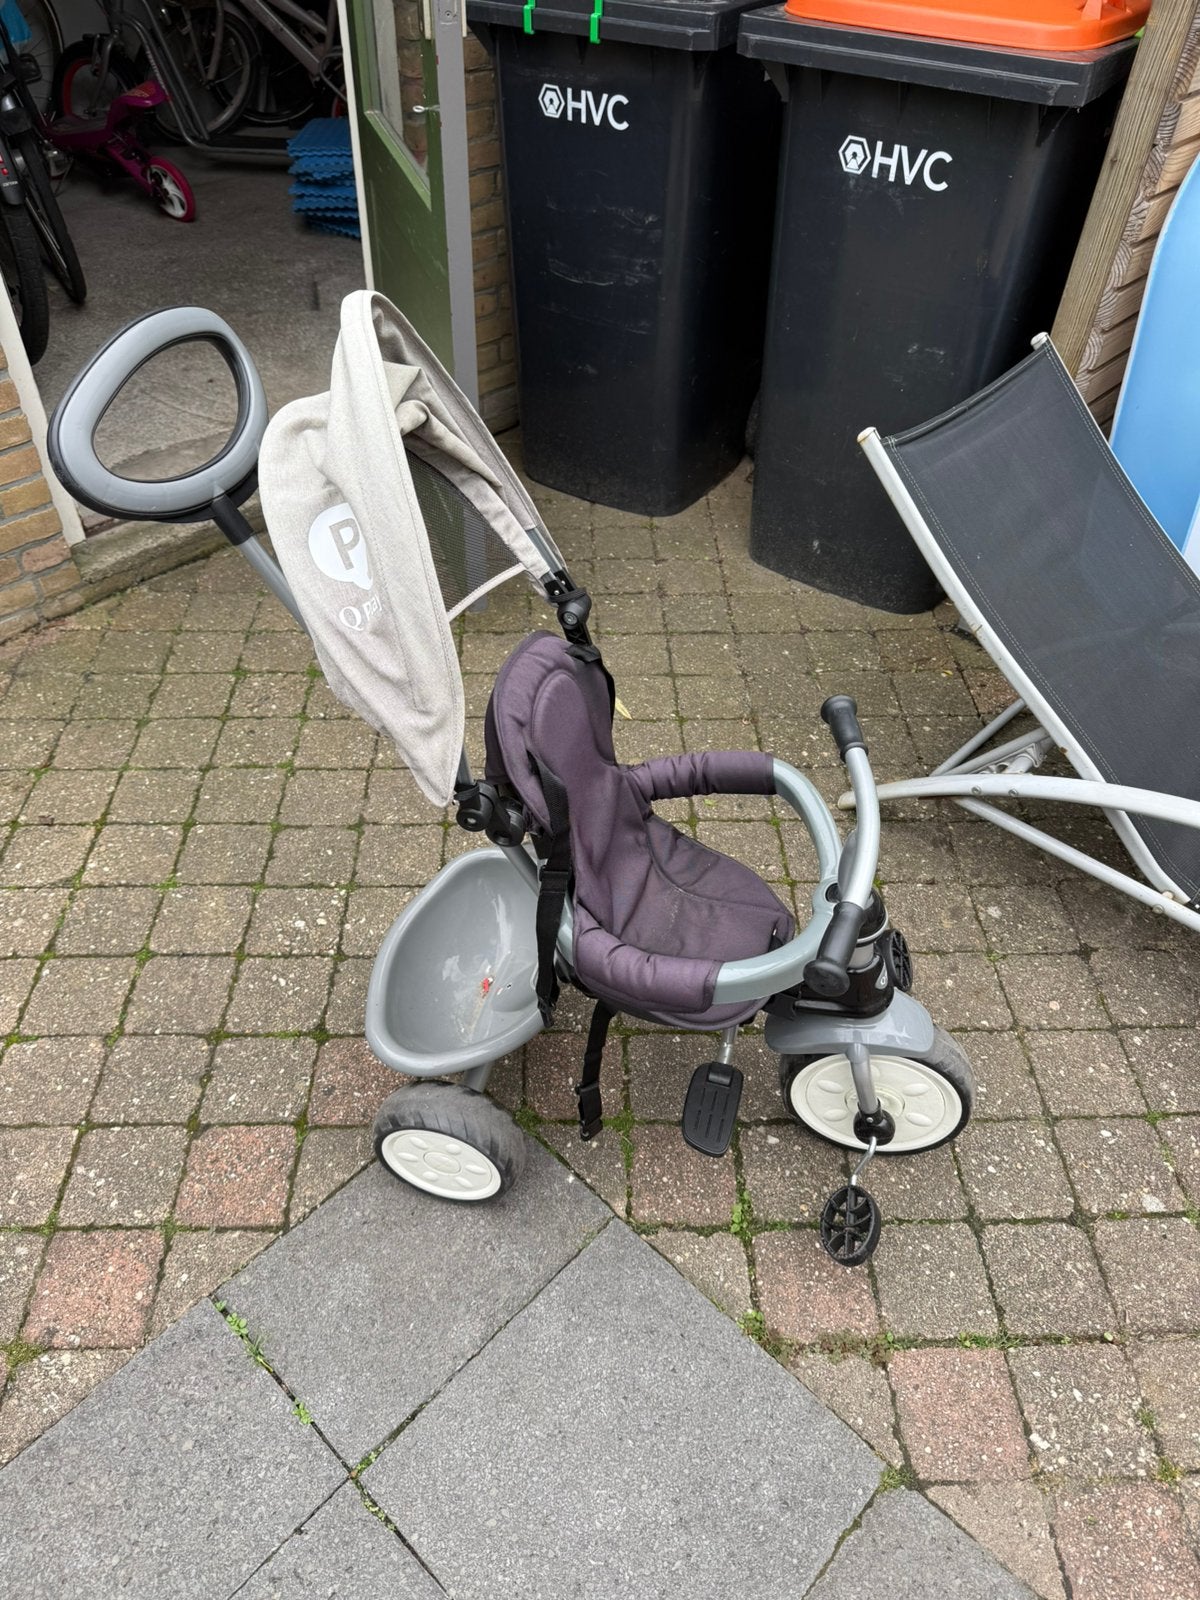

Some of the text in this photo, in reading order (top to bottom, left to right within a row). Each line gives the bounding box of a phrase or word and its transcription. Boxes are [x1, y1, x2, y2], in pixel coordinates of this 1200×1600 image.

[567, 87, 629, 130] HVC
[872, 141, 953, 192] HVC
[329, 518, 361, 570] P
